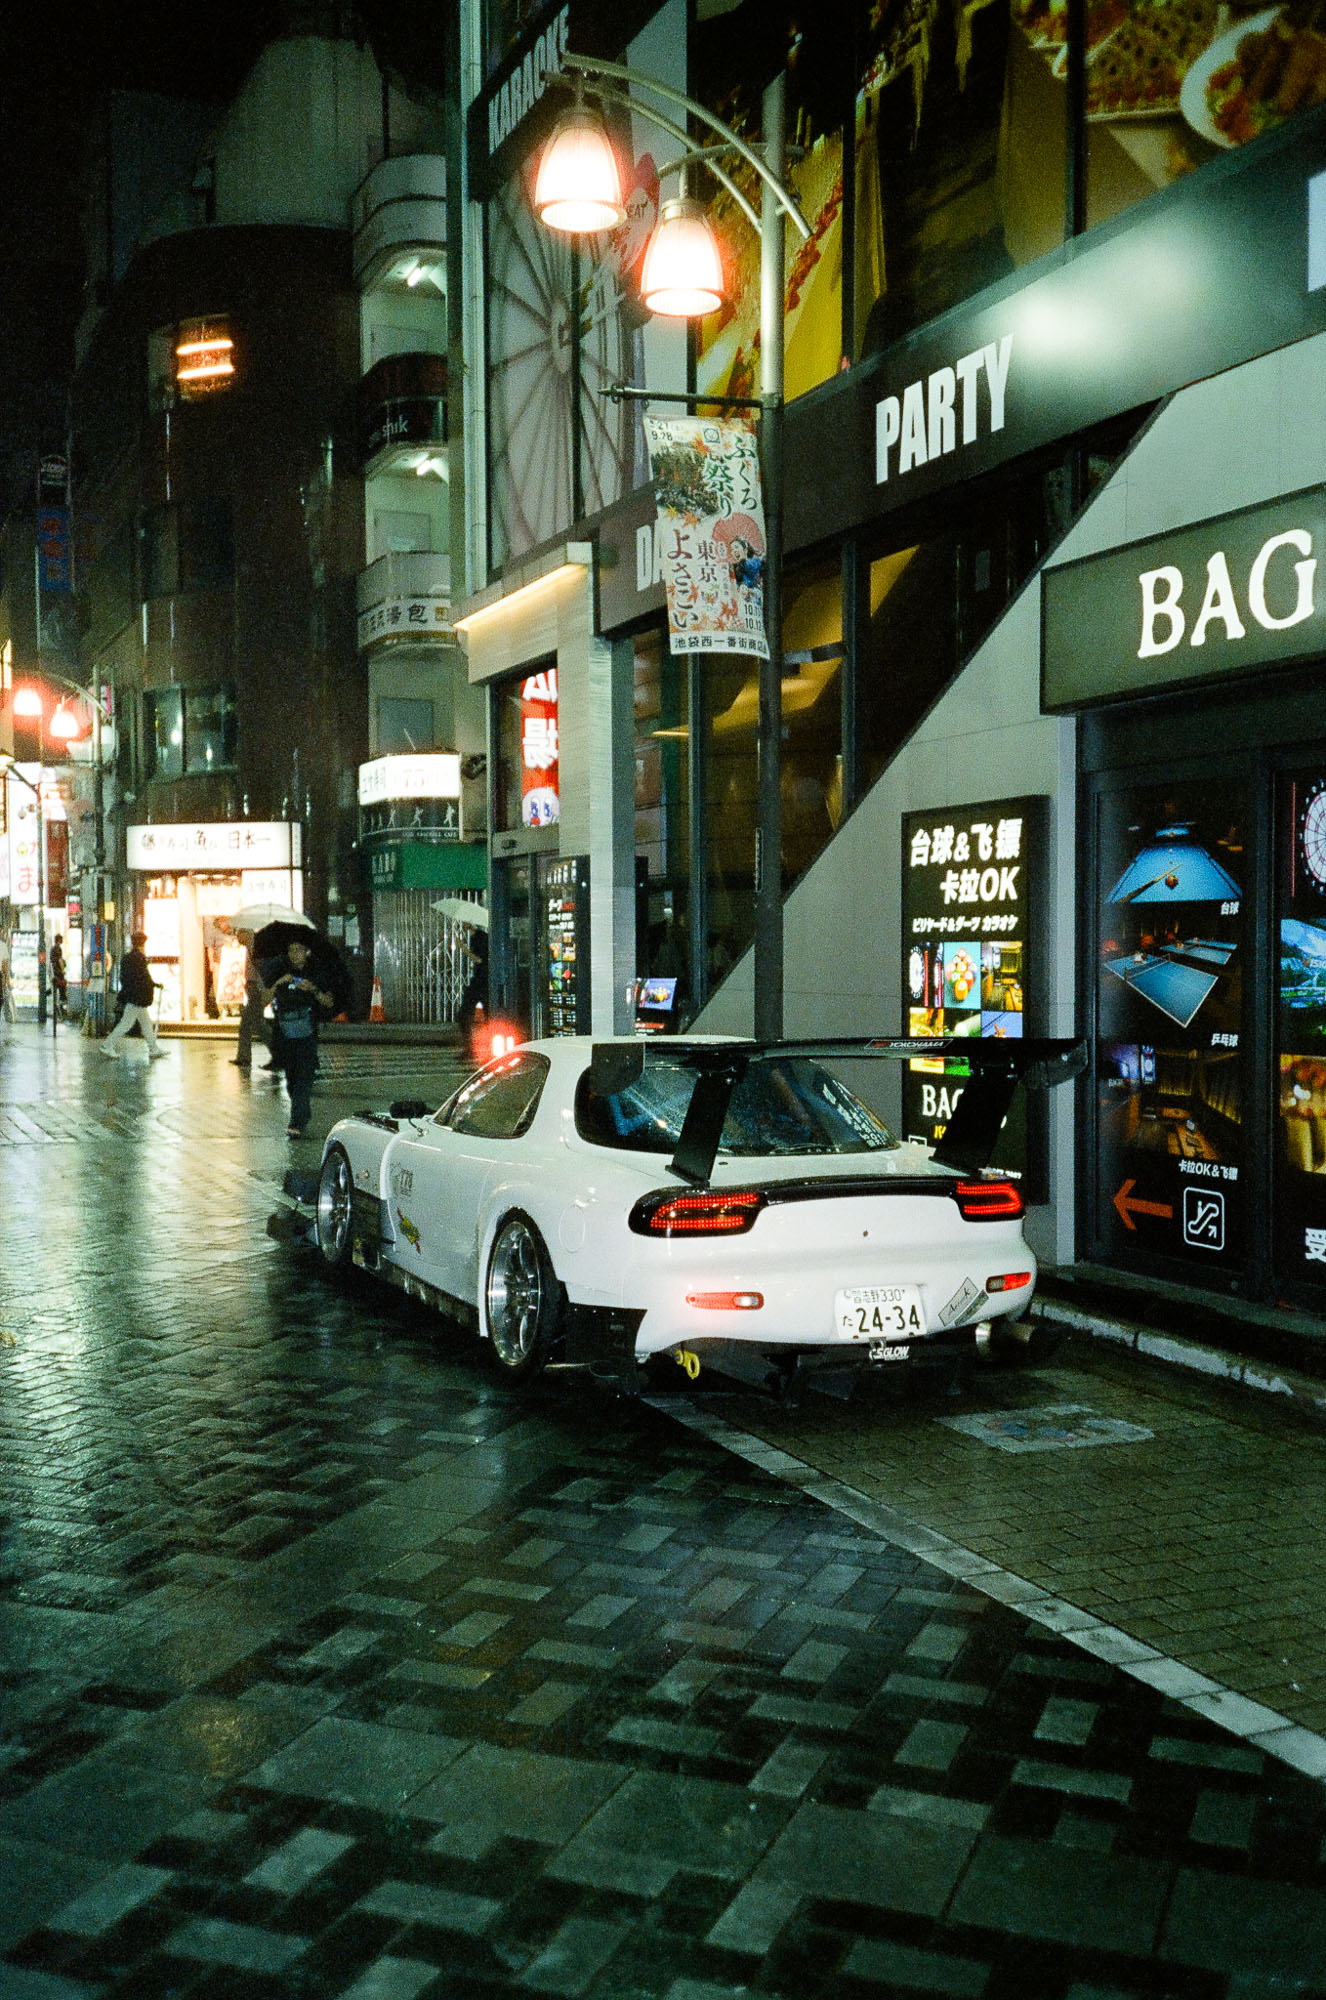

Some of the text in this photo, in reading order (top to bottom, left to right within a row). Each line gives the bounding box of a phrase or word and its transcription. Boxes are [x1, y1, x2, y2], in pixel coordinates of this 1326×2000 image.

[875, 332, 1014, 486] PARTY
[724, 433, 757, 510] ふくろ
[667, 528, 699, 628] よさこい
[697, 540, 718, 582] 東京
[1137, 528, 1318, 659] BAG
[910, 818, 1022, 867] 台球&飞镖
[940, 866, 1020, 904] 卡拉OK
[982, 914, 1019, 932] カラオケ
[1220, 901, 1240, 916] 台球
[889, 1041, 944, 1049] YOKOHAMA
[1211, 1032, 1239, 1047] 乒乓球
[856, 1304, 920, 1333] 24-34
